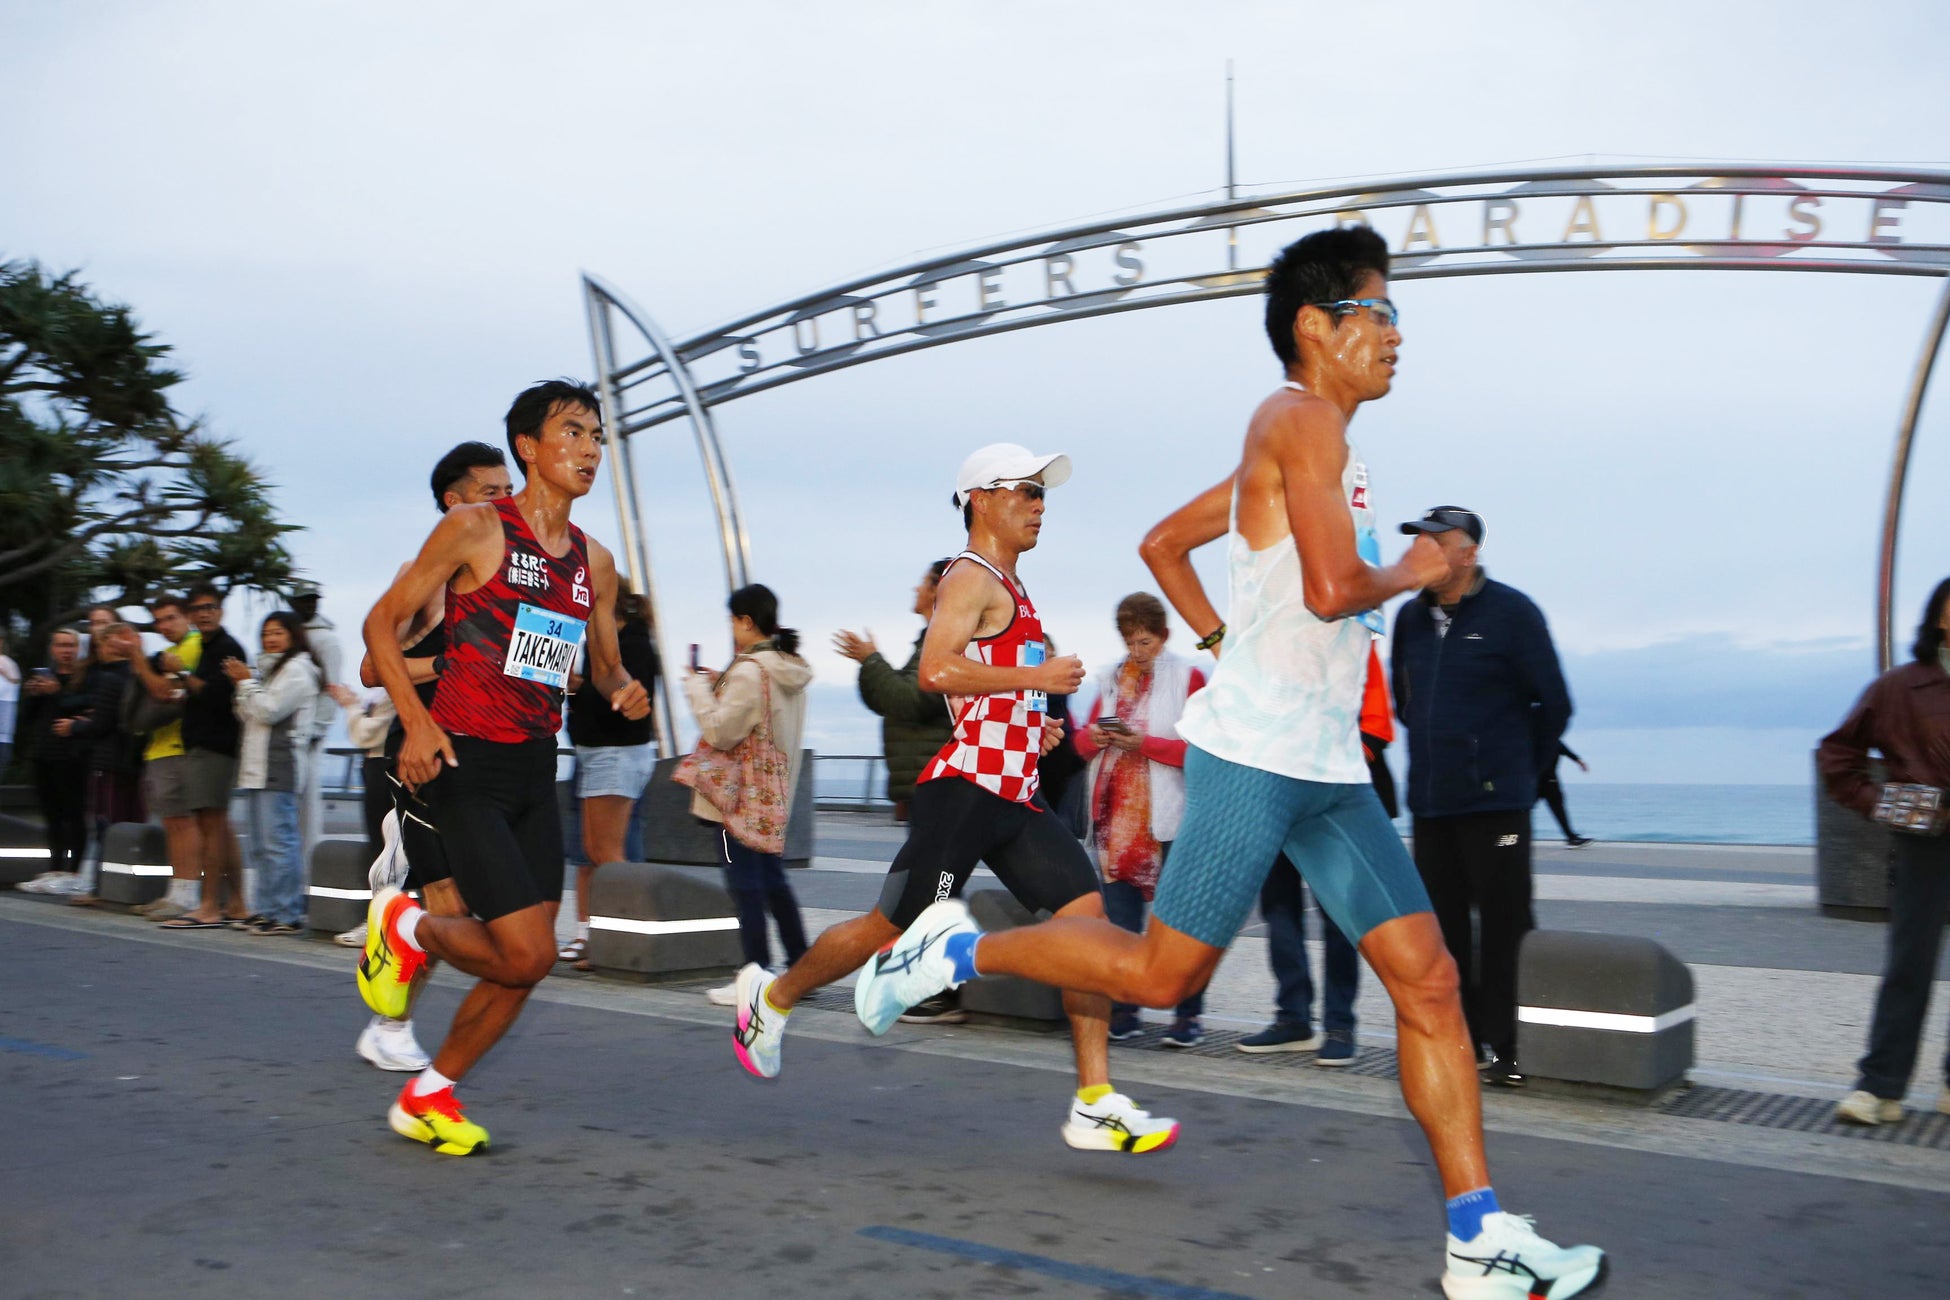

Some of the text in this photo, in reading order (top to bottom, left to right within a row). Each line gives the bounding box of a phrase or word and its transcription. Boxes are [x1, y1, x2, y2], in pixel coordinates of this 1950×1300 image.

[738, 241, 1145, 373] SURFERS
[574, 588, 588, 603] JTB
[546, 619, 563, 638] 34
[512, 631, 575, 674] TAKEMARU
